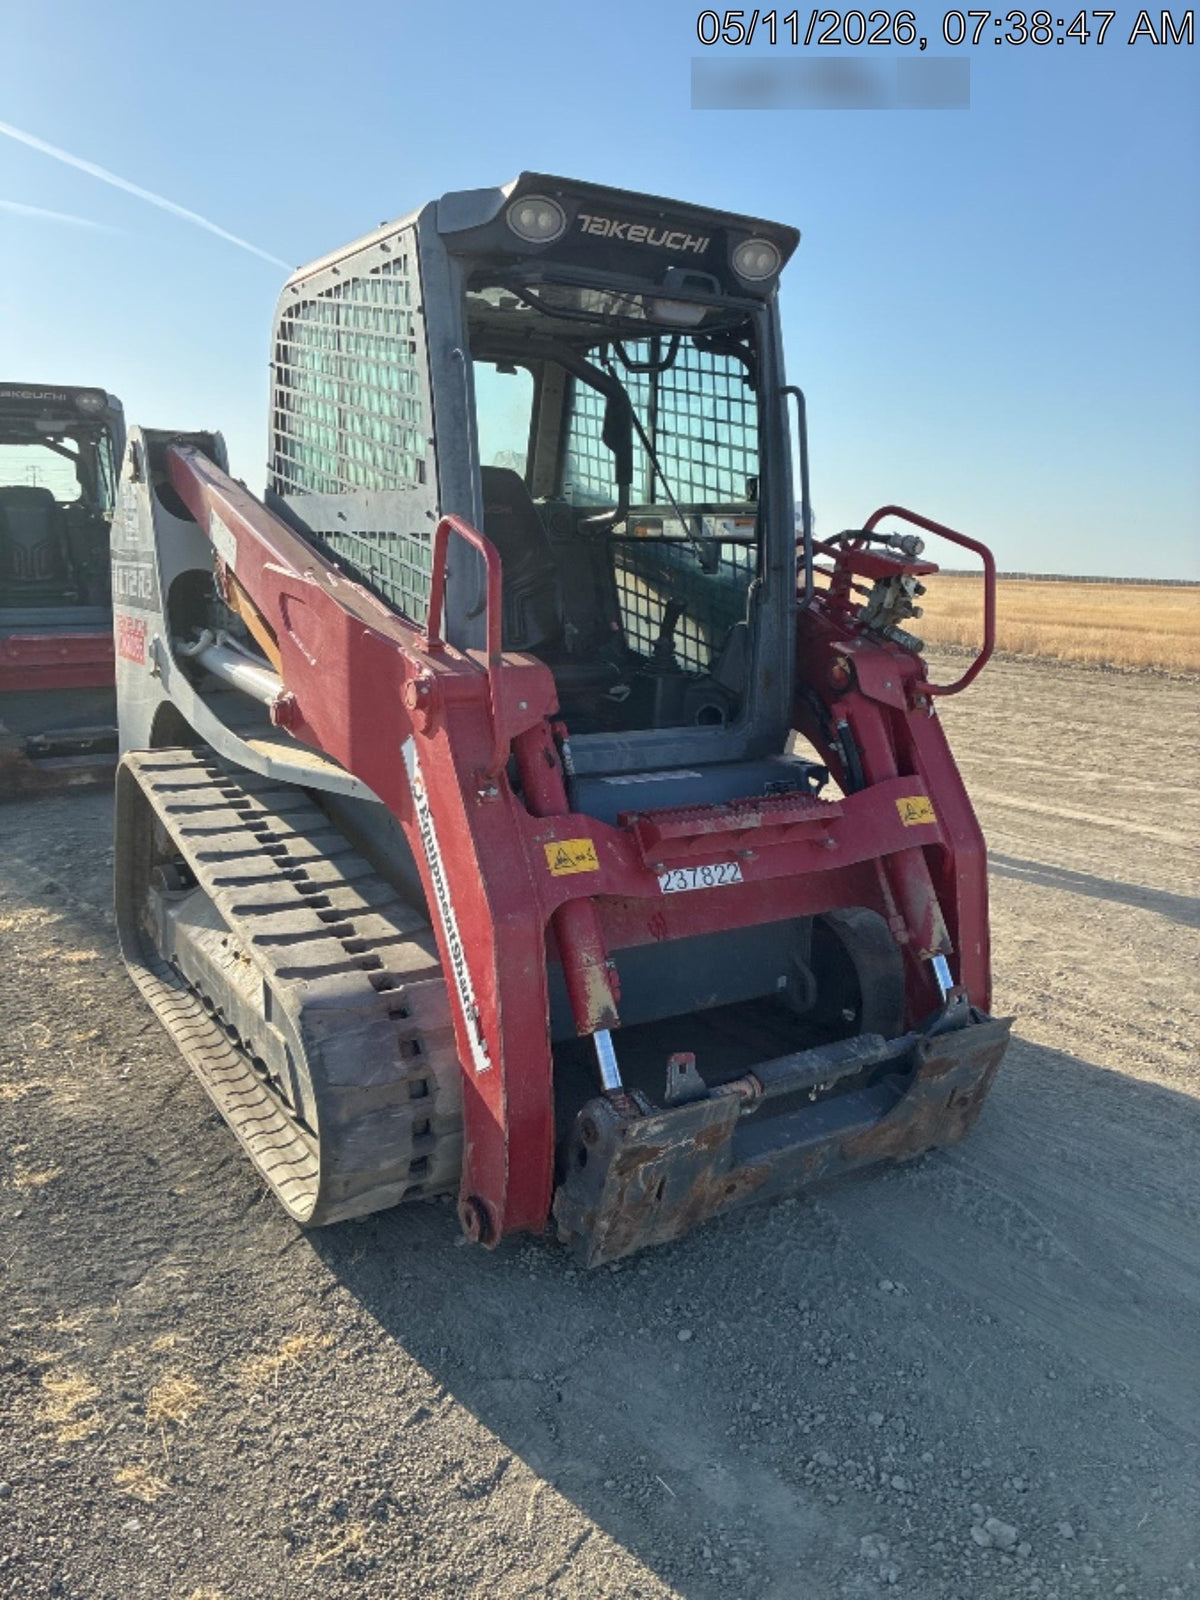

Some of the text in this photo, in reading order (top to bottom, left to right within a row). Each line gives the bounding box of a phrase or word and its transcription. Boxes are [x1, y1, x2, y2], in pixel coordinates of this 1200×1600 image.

[577, 213, 711, 254] TAKEUCHI
[0, 390, 67, 401] AKEUCHI
[662, 862, 743, 892] 237822
